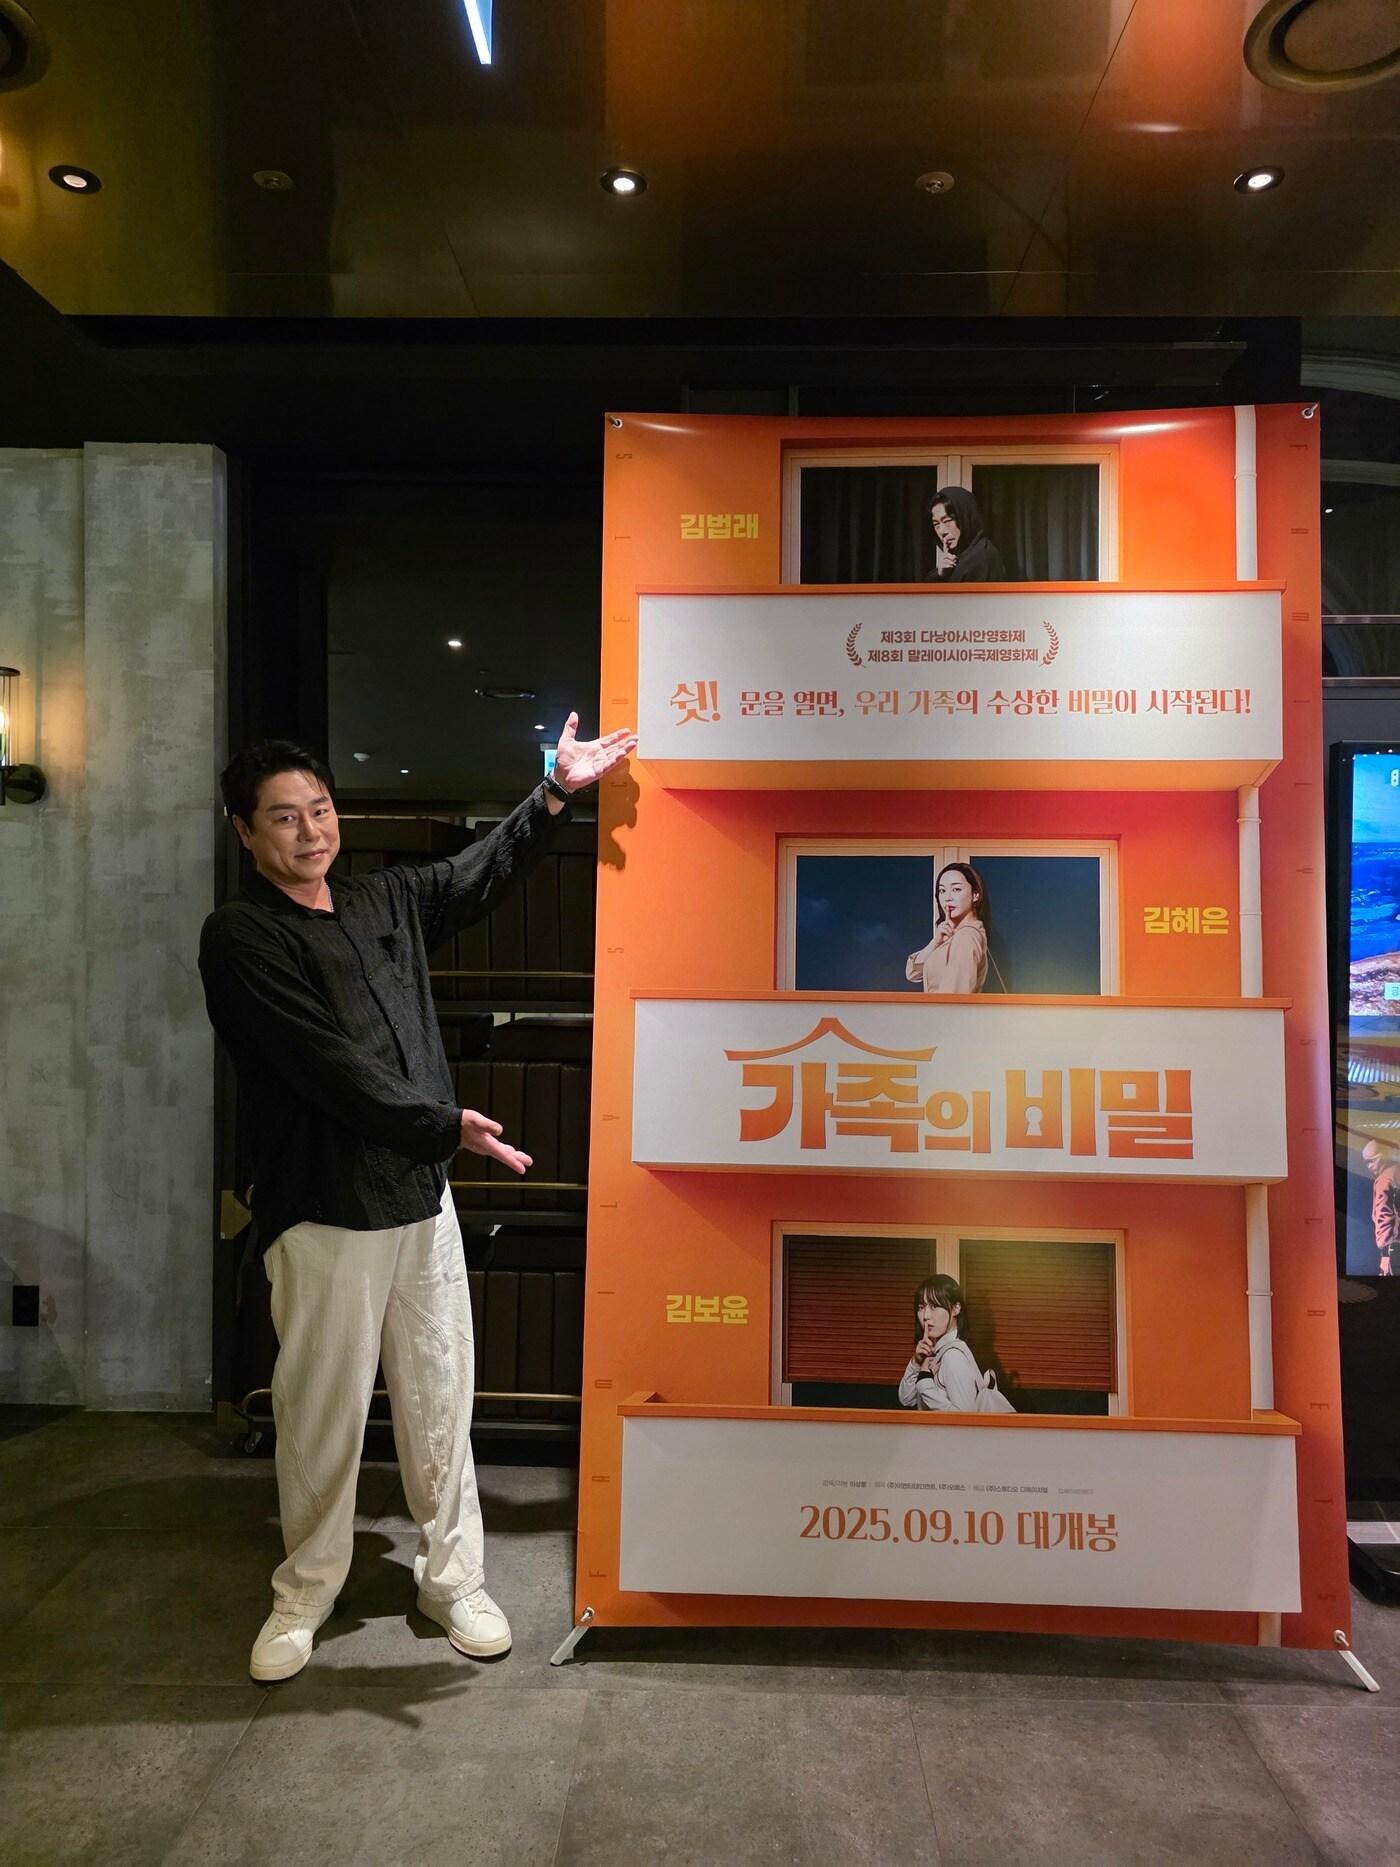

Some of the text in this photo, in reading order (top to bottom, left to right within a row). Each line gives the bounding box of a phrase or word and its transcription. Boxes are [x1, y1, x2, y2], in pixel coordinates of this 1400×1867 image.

[680, 513, 759, 540] 김법래
[880, 629, 1026, 644] 제3회 다낭아시안영화제
[867, 648, 1039, 662] 제8회 말레이시아국제영화제
[670, 680, 1251, 727] 쉿! 문을 열면, 우리 가족의 수상한 비밀이 시작된다!
[1143, 906, 1229, 935] 김혜은
[738, 1062, 1194, 1161] 가족의 비밀
[666, 1294, 748, 1325] 김보윤
[799, 1504, 1119, 1553] 2025.09.10 대개봉
